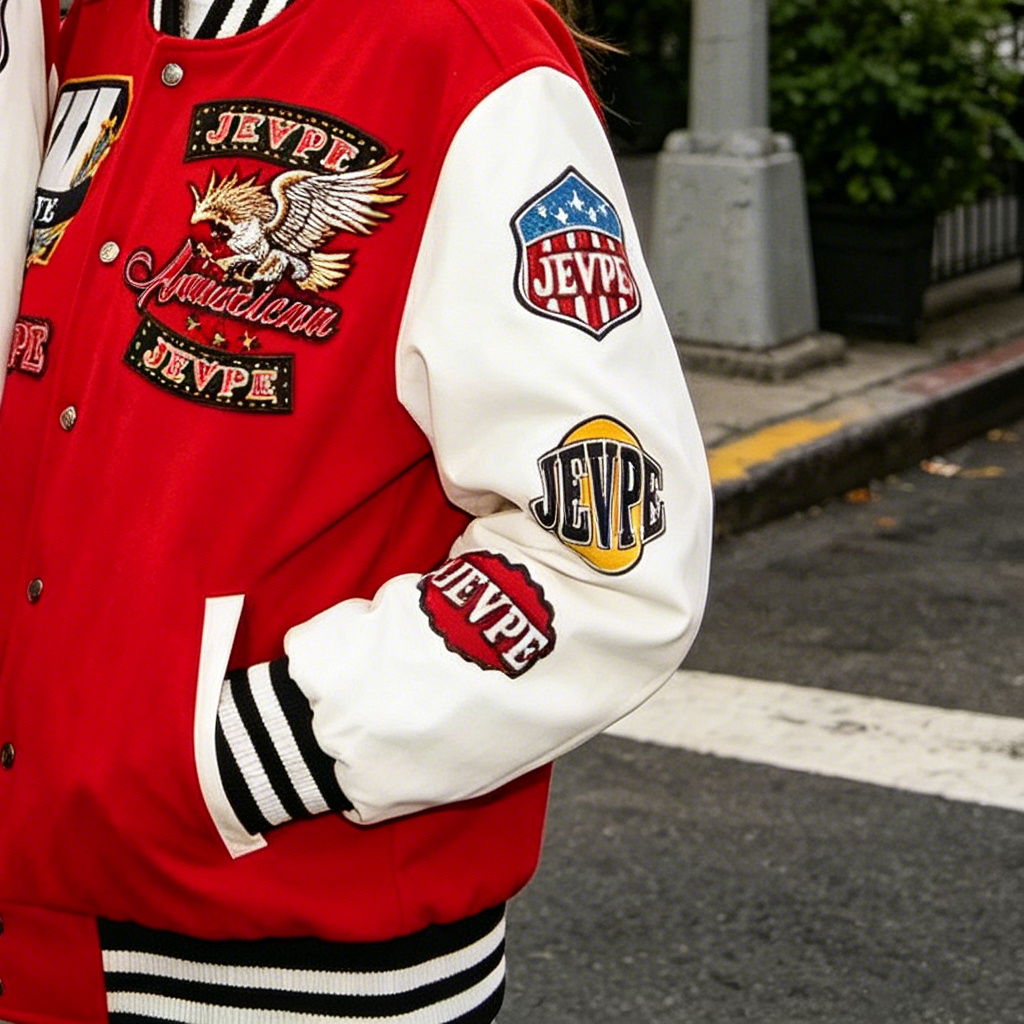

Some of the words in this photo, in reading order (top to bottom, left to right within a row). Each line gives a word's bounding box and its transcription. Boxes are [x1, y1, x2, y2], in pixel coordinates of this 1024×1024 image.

[205, 111, 360, 173] JEVPE
[532, 250, 635, 297] JEVPE
[142, 336, 278, 405] JEVPE
[529, 438, 667, 551] JEVPE
[431, 558, 550, 671] JEVPE
